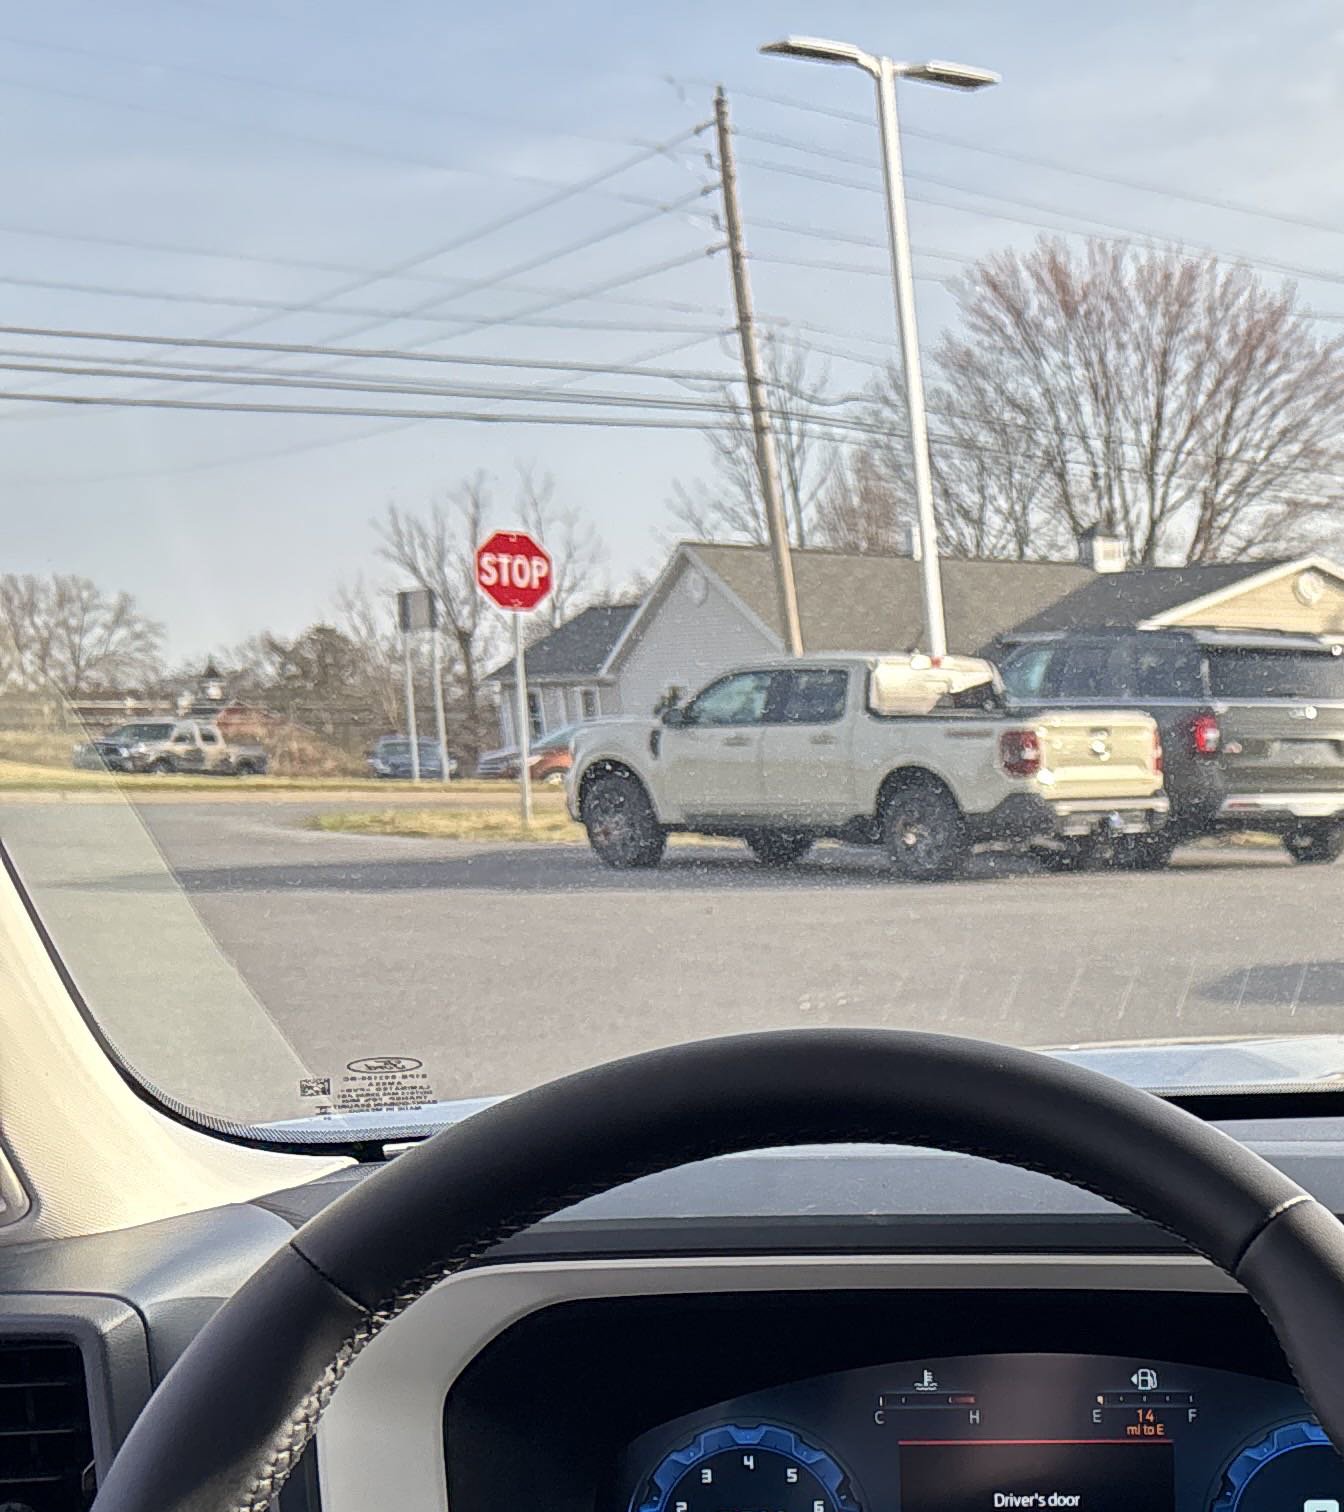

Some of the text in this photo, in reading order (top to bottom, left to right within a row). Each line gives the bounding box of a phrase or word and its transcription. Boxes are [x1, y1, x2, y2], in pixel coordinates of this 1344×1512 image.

[479, 551, 549, 590] STOP
[873, 1410, 885, 1425] C
[969, 1410, 980, 1425] H
[1092, 1409, 1102, 1423] E
[1136, 1408, 1155, 1423] 14
[1188, 1408, 1197, 1423] F
[1142, 1424, 1155, 1436] to
[1156, 1424, 1165, 1436] E
[743, 1455, 754, 1470] 4
[701, 1469, 712, 1484] 3
[786, 1468, 798, 1483] 5
[993, 1492, 1080, 1508] Driver's door
